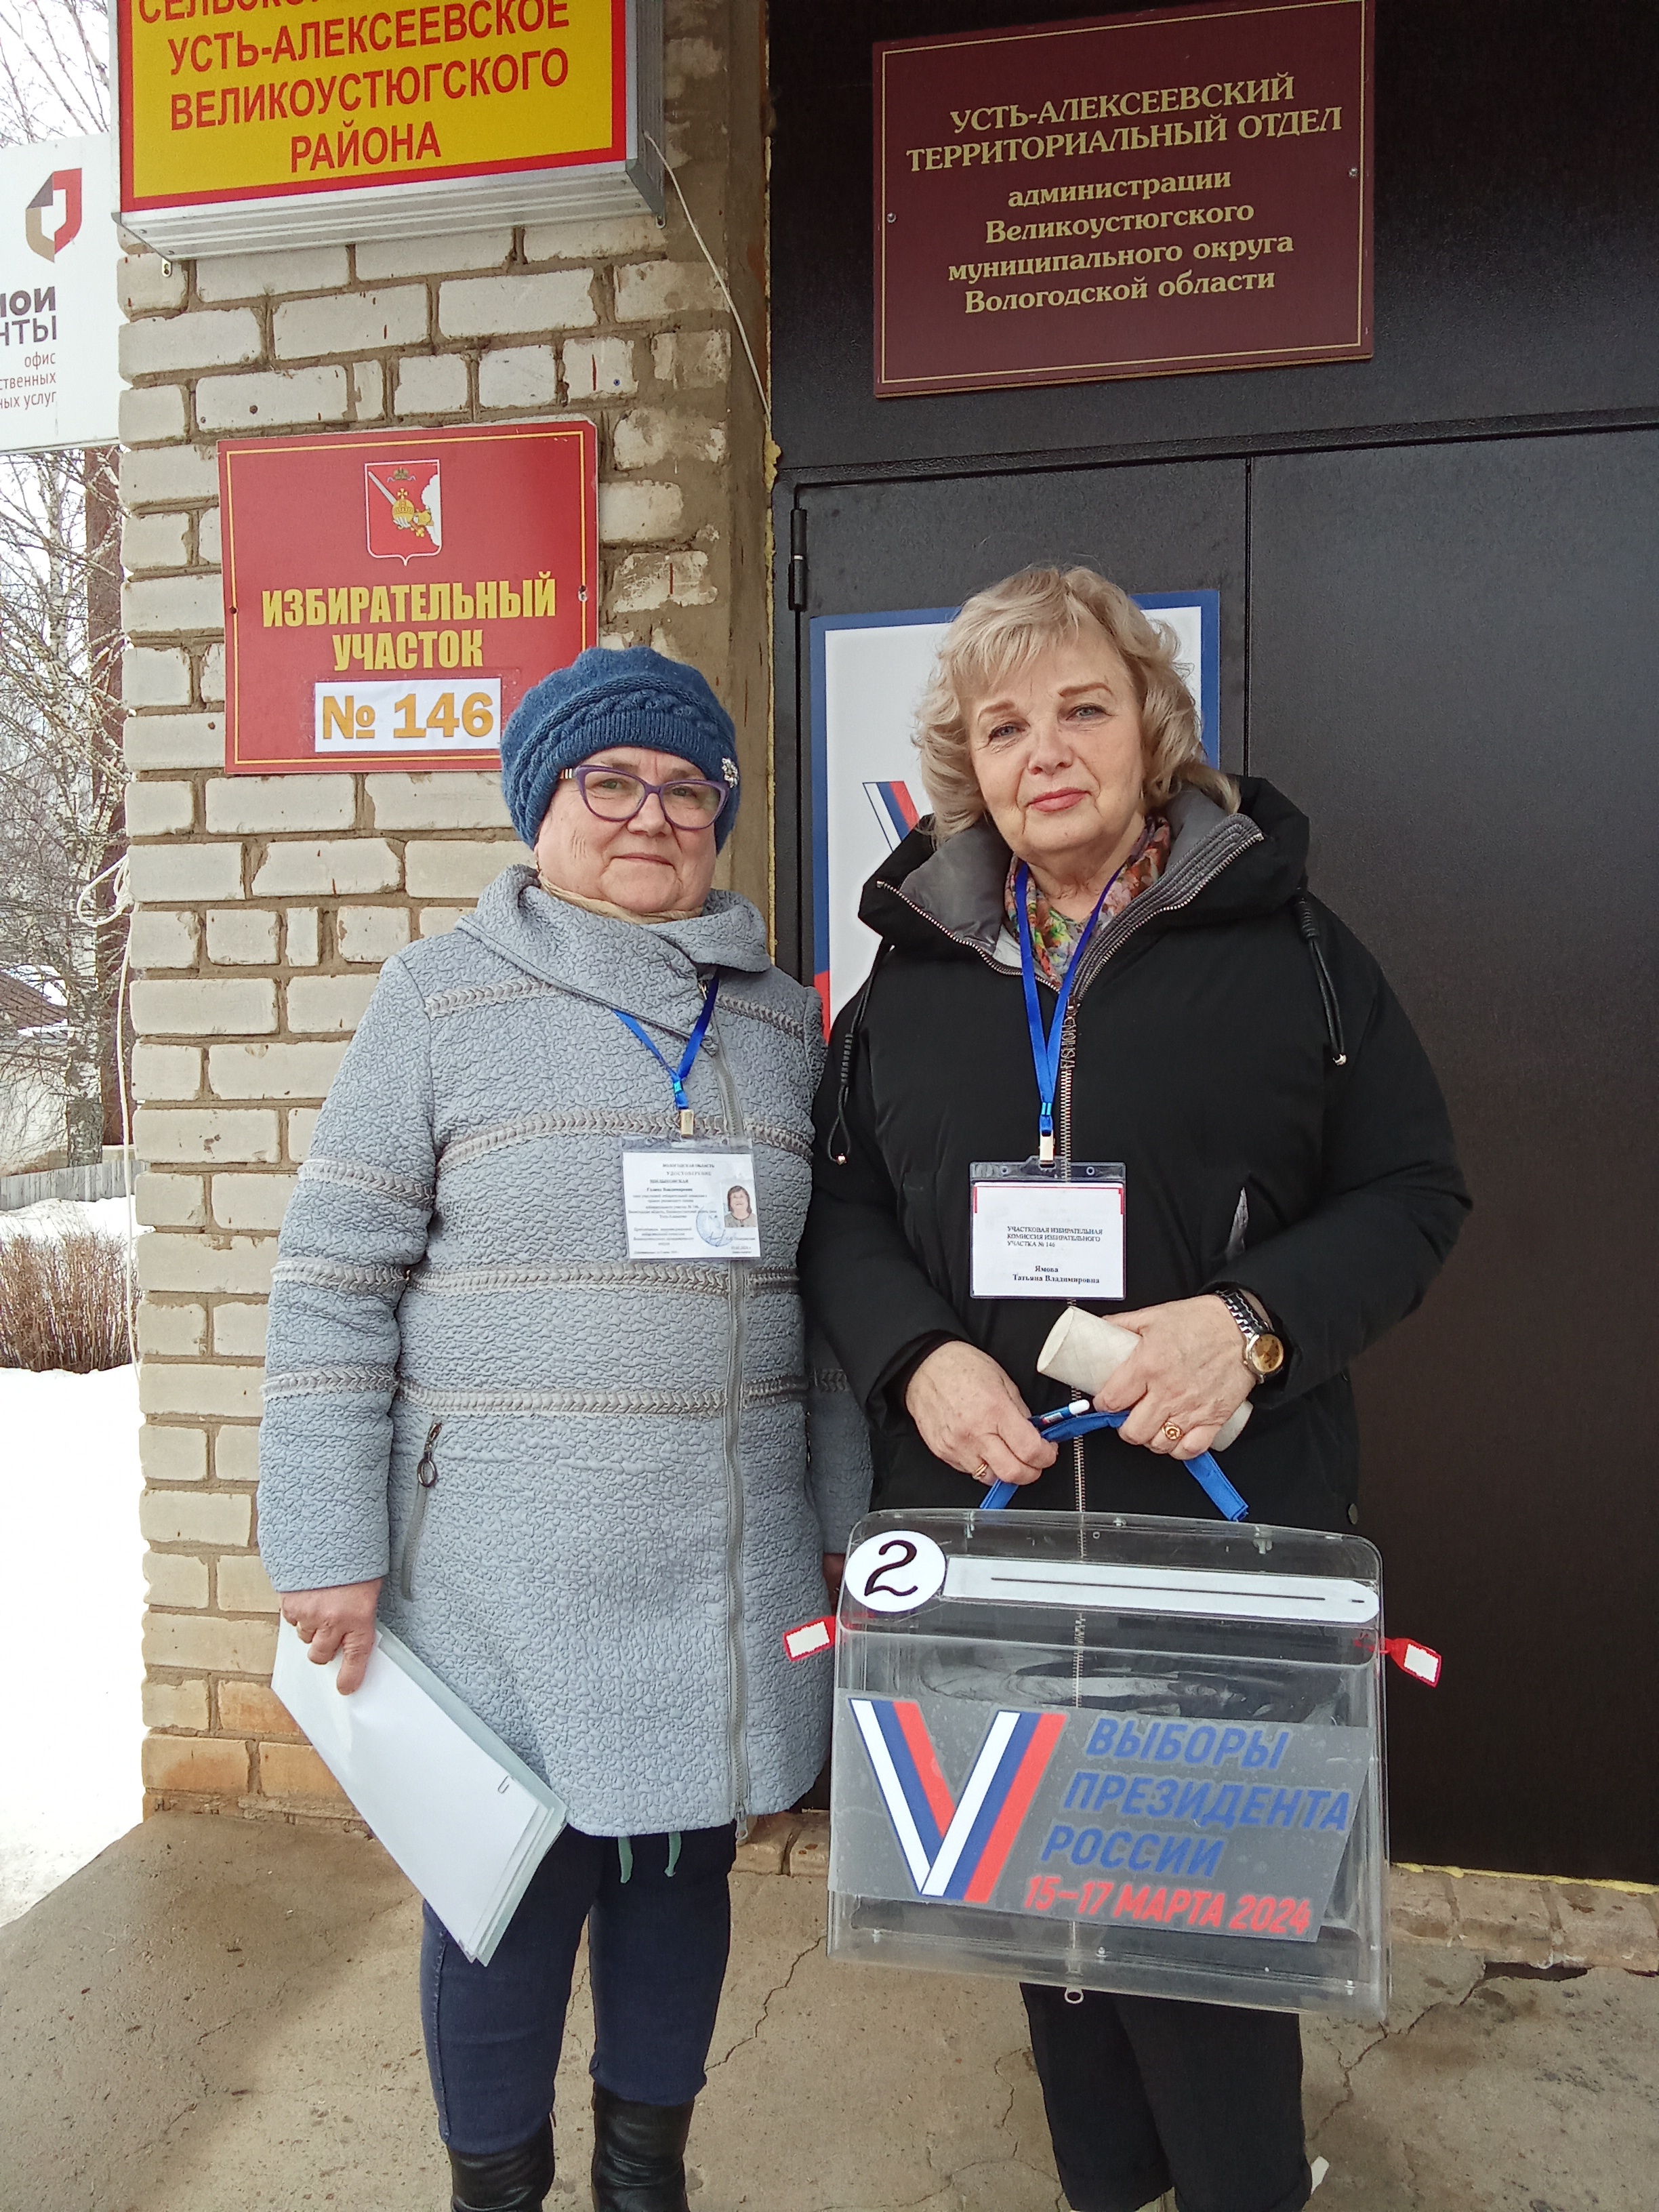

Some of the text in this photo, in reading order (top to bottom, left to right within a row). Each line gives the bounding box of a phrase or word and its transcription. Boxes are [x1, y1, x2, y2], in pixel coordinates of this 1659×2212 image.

[168, 0, 569, 75] УСТЬ-АЛЕКСЕЕВСКОЕ
[172, 47, 569, 130] ВЕЛИКОУСТЮГСКОГО
[950, 72, 1295, 134] УСТЬ-АЛЕКСЕЕВСКИЙ
[291, 121, 441, 173] РАЙОНА
[906, 106, 1343, 172] ТЕРРИТОРИАЛЬНЫЙ ОТДЕЛ
[1008, 171, 1231, 210] администрации
[985, 203, 1254, 243] Великоустюгского
[948, 234, 1294, 283] муниципального округа
[965, 270, 1275, 313] Вологодской области
[24, 352, 56, 370] офис
[24, 392, 56, 411] услуг
[262, 571, 556, 627] ИЗБИРАТЕЛЬНЫЙ
[332, 630, 483, 671] УЧАСТОК
[323, 692, 494, 739] № 146
[1045, 1275, 1100, 1285] Владимировна
[863, 1539, 918, 1597] 2
[1086, 1717, 1290, 1770] ВЫБОРЫ
[1063, 1771, 1350, 1831] ПРЕЗИДЕНТА
[1041, 1824, 1225, 1878] РОССИИ
[1113, 1883, 1225, 1929] МАРТА
[1229, 1893, 1313, 1936] 2024
